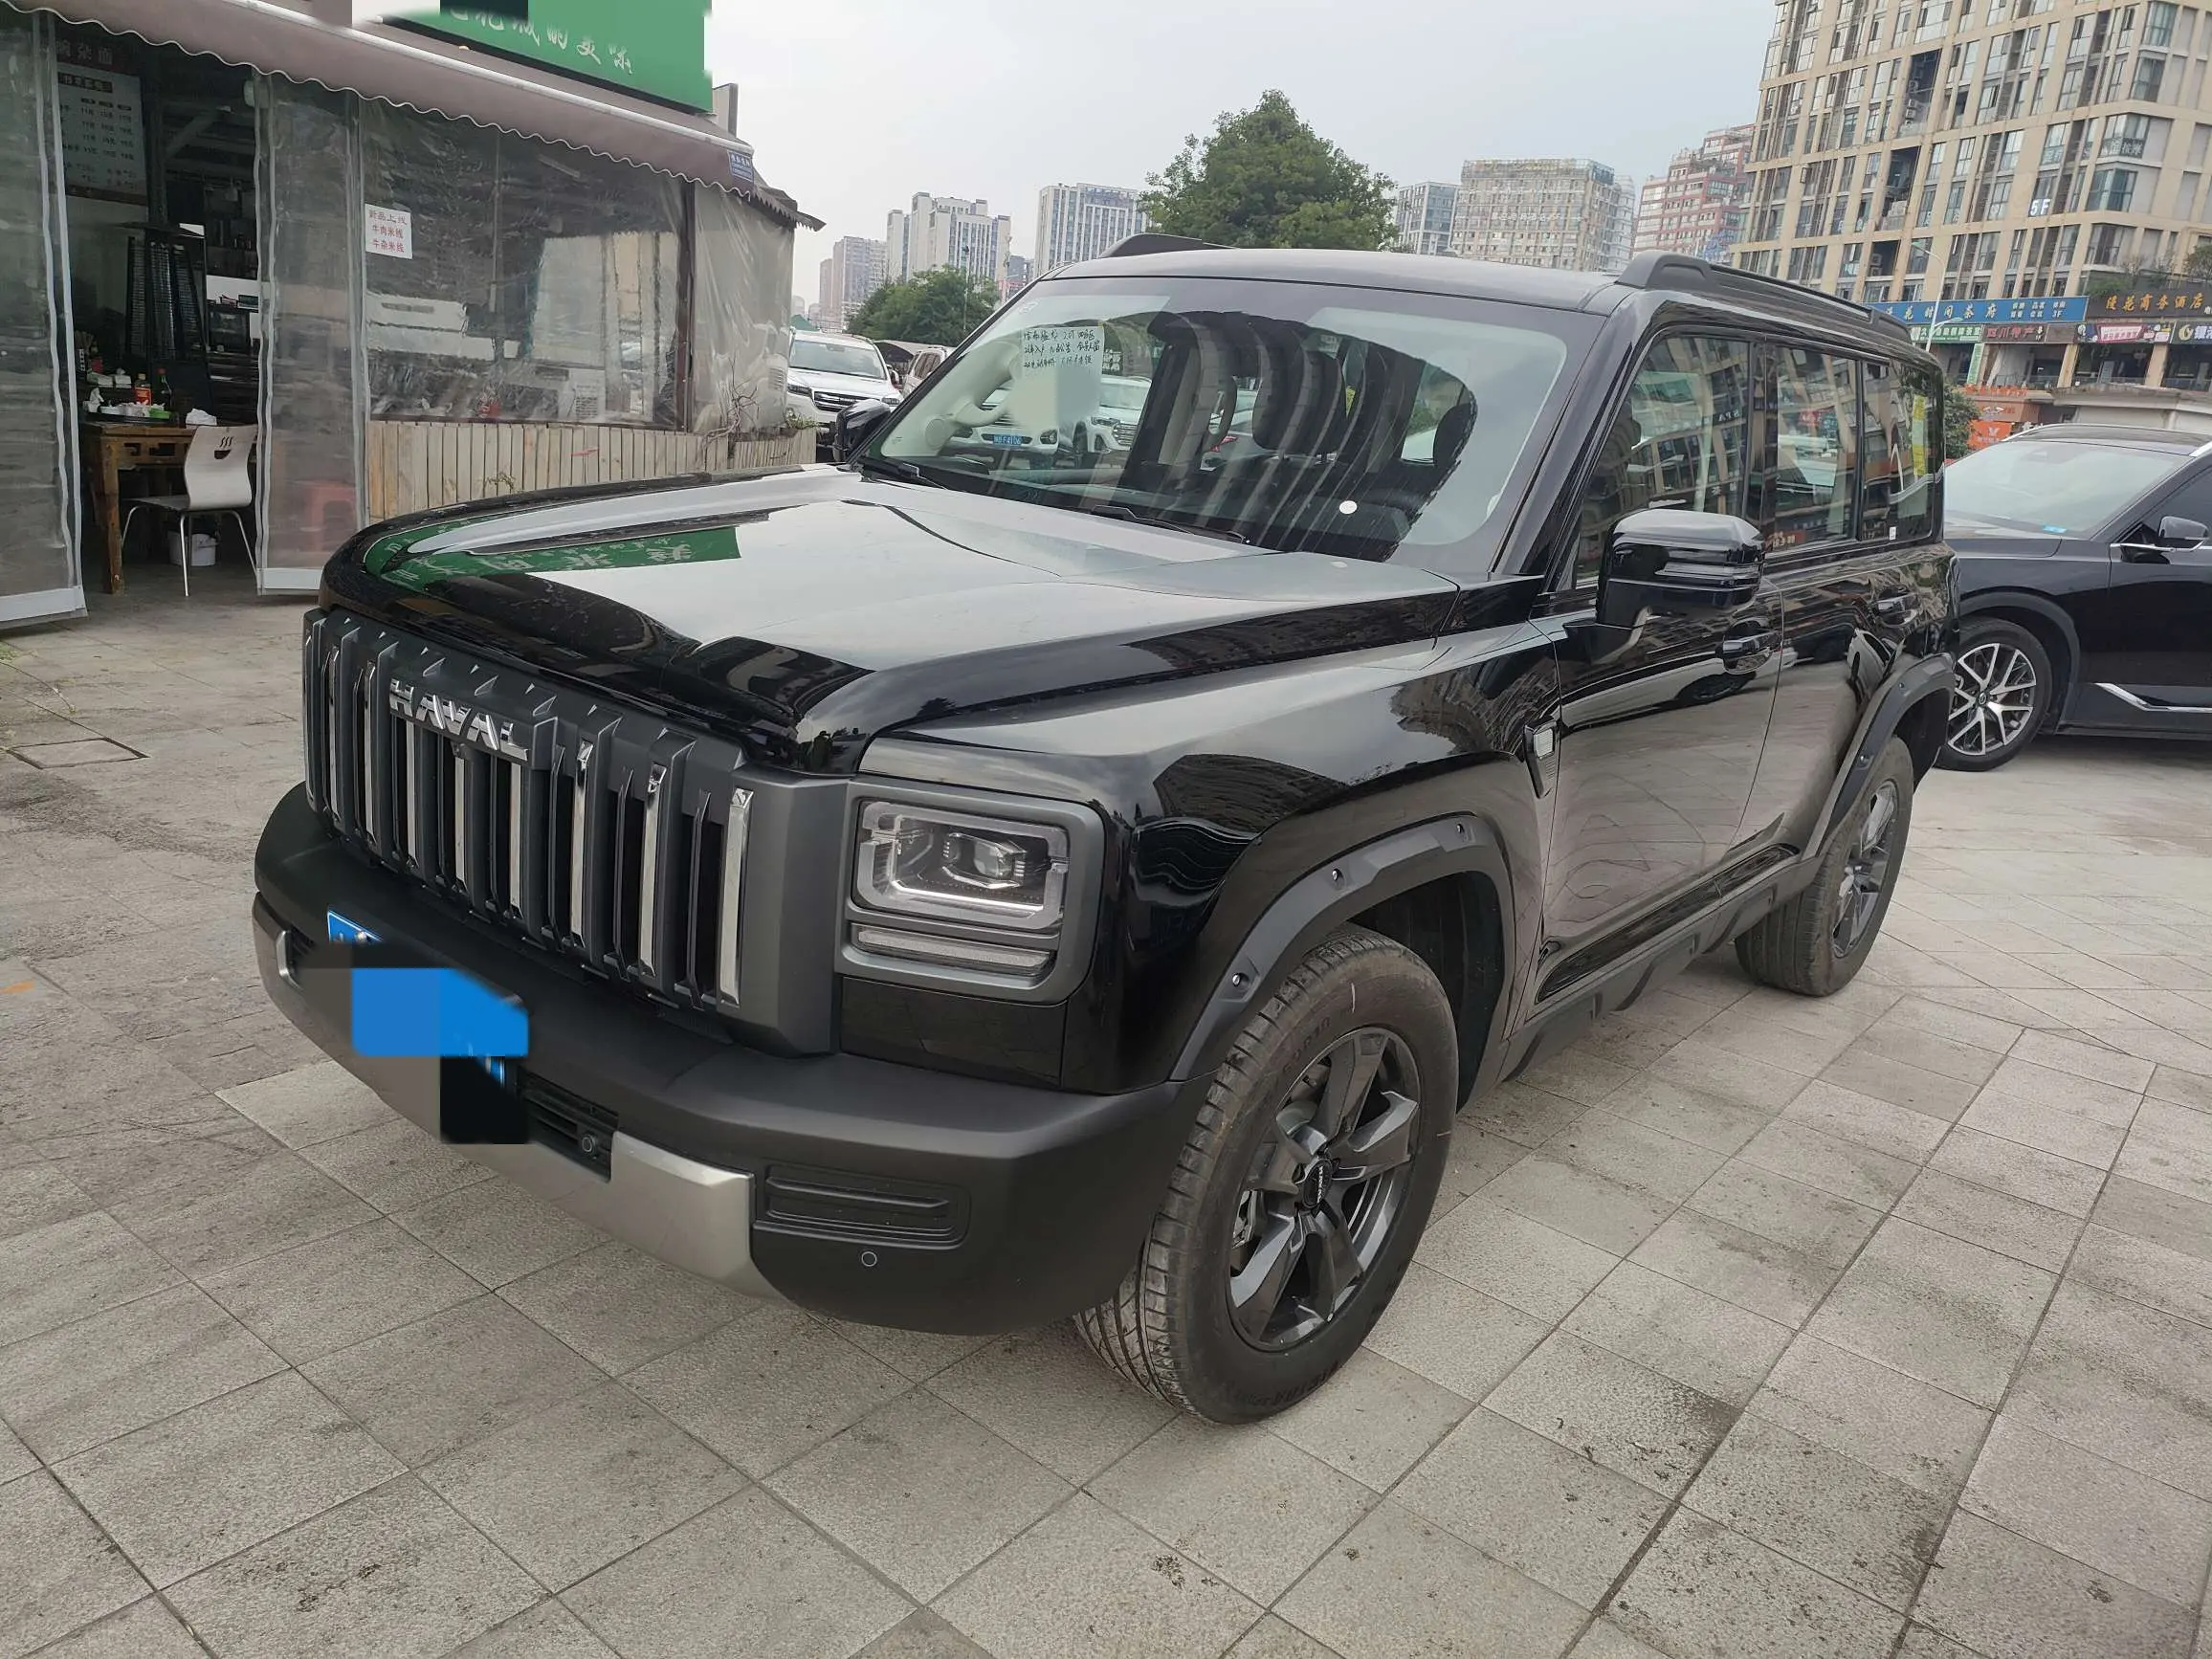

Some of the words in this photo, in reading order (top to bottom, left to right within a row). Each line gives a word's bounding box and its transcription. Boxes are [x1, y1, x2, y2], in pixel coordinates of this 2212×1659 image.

[1987, 325, 2035, 339] 四川特产
[389, 677, 529, 762] HAVAL
